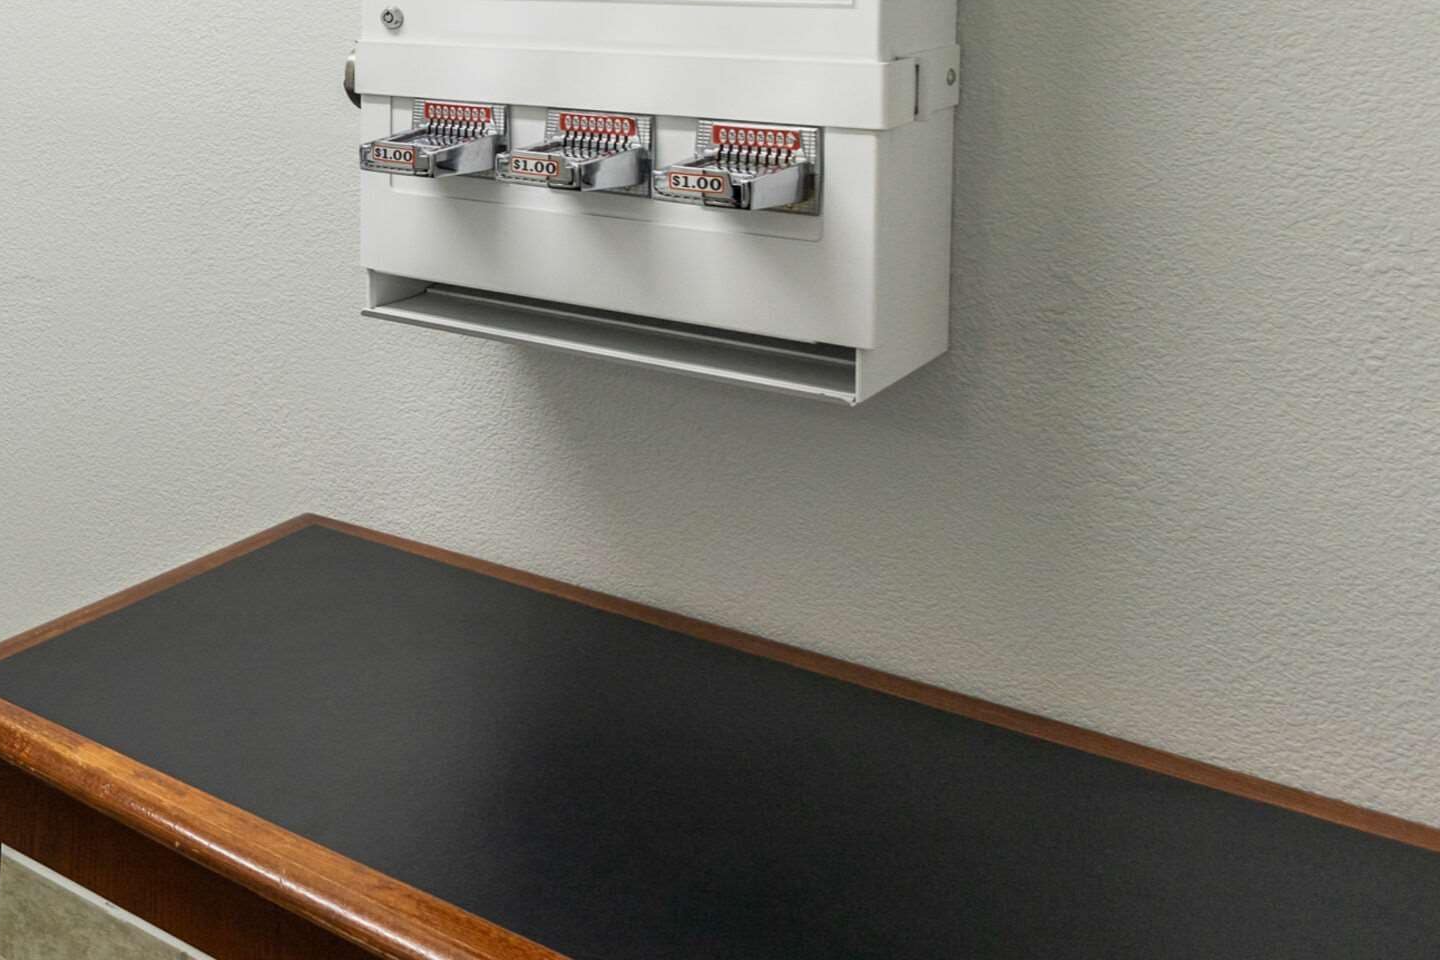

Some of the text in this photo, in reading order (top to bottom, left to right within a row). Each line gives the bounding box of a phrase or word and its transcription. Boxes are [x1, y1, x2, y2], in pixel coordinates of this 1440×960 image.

[374, 146, 413, 163] $1.00
[512, 158, 556, 176] $1.00
[672, 174, 722, 193] $1.00
